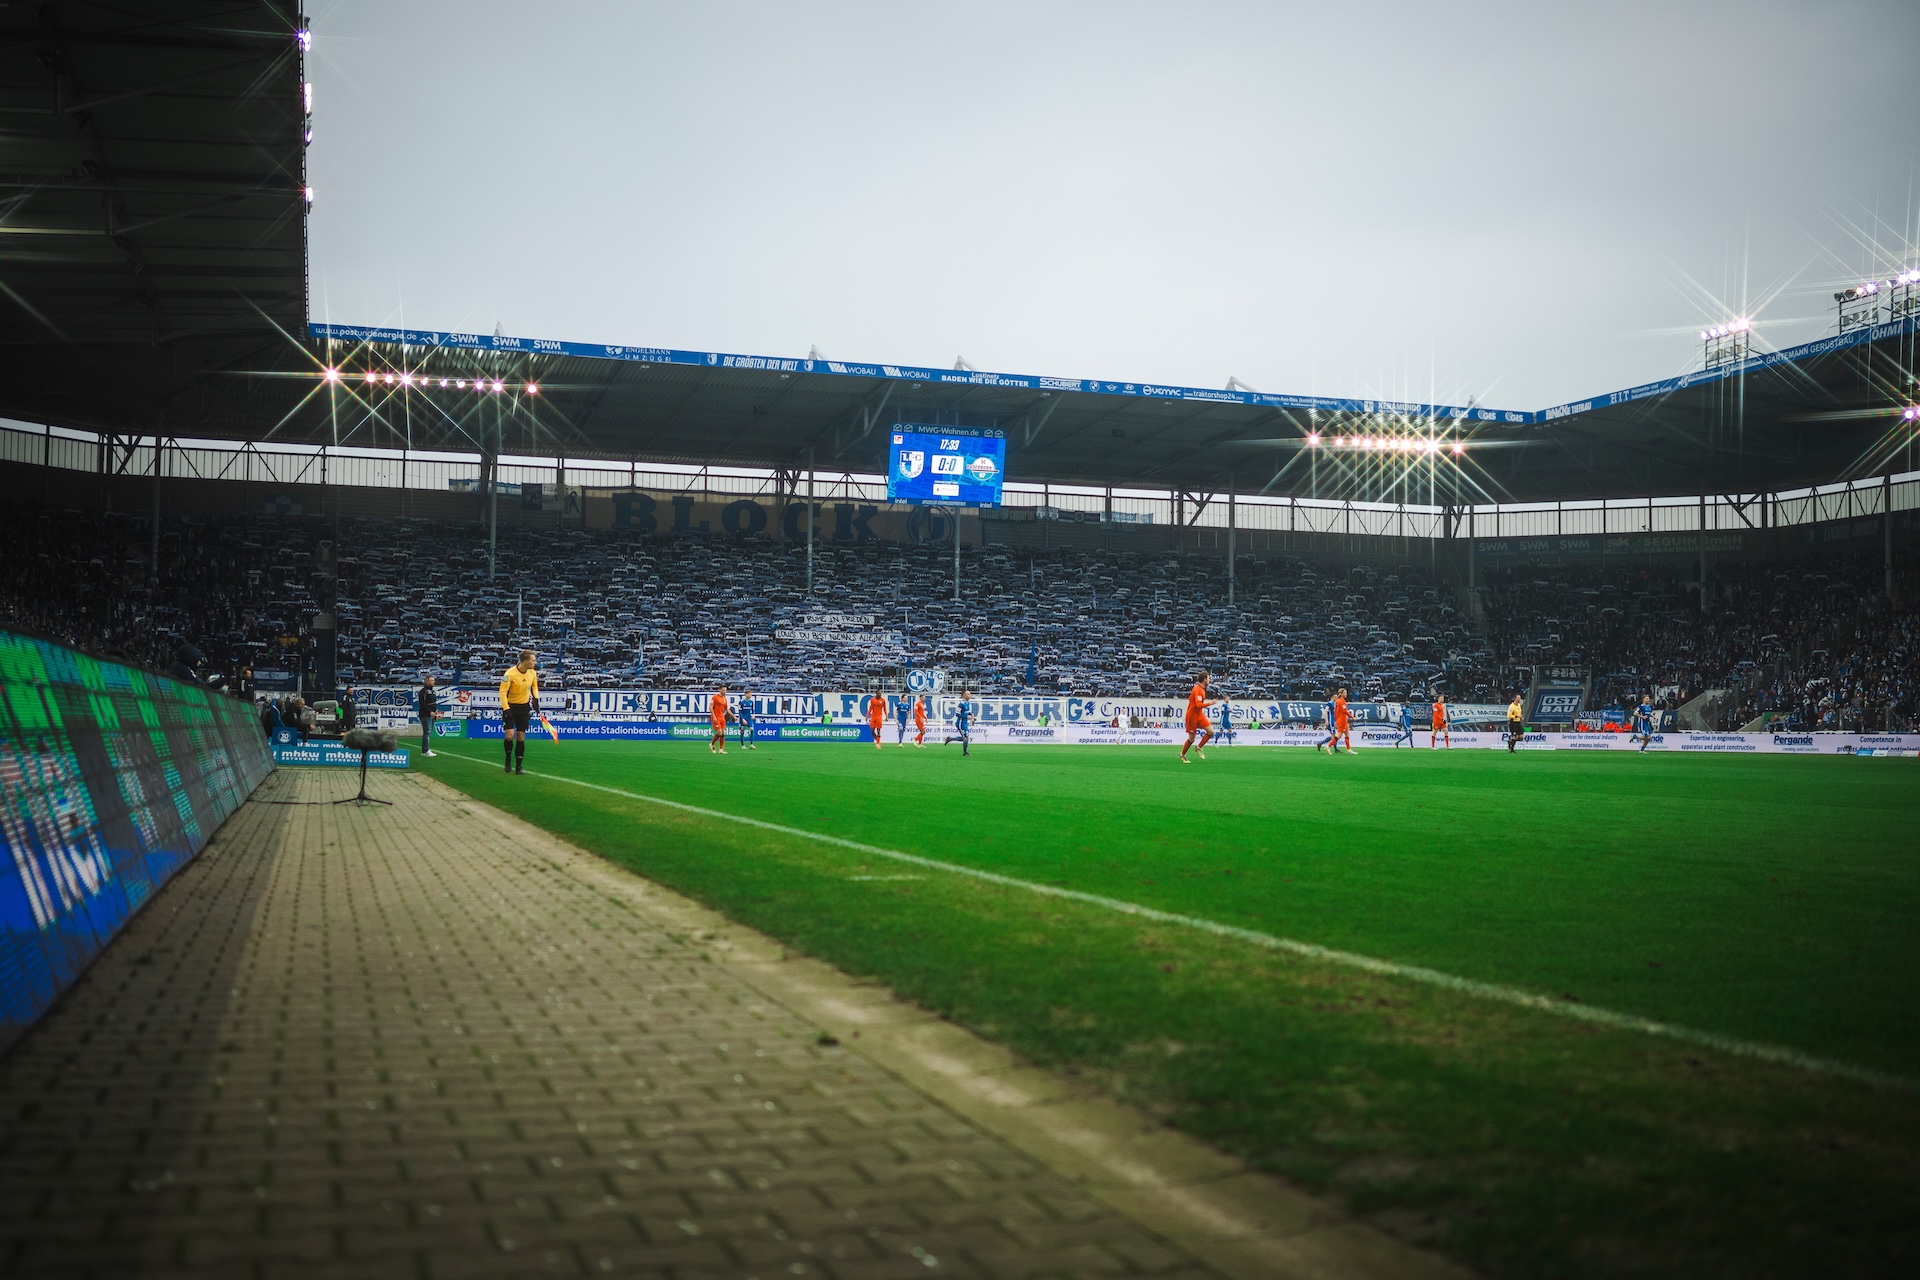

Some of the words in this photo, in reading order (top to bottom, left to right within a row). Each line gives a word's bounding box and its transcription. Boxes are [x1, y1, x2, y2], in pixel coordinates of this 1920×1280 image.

[450, 333, 479, 344] SWM
[492, 336, 521, 347] SWM
[533, 339, 562, 350] SWM
[1766, 346, 1809, 364] GARTEMANN
[723, 356, 734, 366] DIE
[766, 358, 781, 370] DER
[781, 360, 798, 371] WELT
[848, 366, 876, 375] WOBAU
[902, 370, 931, 379] WOBAU
[941, 375, 967, 383] BADEN
[998, 377, 1029, 387] GÖTTER
[918, 426, 979, 436] MWG-Wohnen.de
[940, 439, 960, 450] 17:33
[611, 492, 883, 542] BLOCK
[1519, 540, 1549, 550] SWM
[1559, 539, 1590, 549] SWM
[1643, 537, 1697, 546] SEGUIN
[1478, 542, 1508, 552] SWM
[806, 615, 827, 623] RUHE
[841, 615, 870, 624] FRIEDEN
[567, 691, 634, 713] BLUE
[652, 692, 814, 718] GENRTION
[1544, 697, 1577, 705] OST
[1231, 704, 1265, 720] Side
[1287, 702, 1311, 718] für
[1541, 705, 1575, 713] BAU
[483, 724, 497, 733] Du
[587, 725, 600, 734] des
[601, 725, 667, 735] Stadionbesuchs
[757, 728, 777, 736] oder
[782, 728, 800, 737] hast
[801, 727, 830, 737] Gewalt
[831, 728, 861, 737] erlebt?
[1008, 727, 1055, 737] Pergande
[1361, 731, 1402, 740] Pergande
[1773, 735, 1814, 745] Pergande
[1860, 736, 1895, 744] Competence
[281, 750, 320, 758] mhkw
